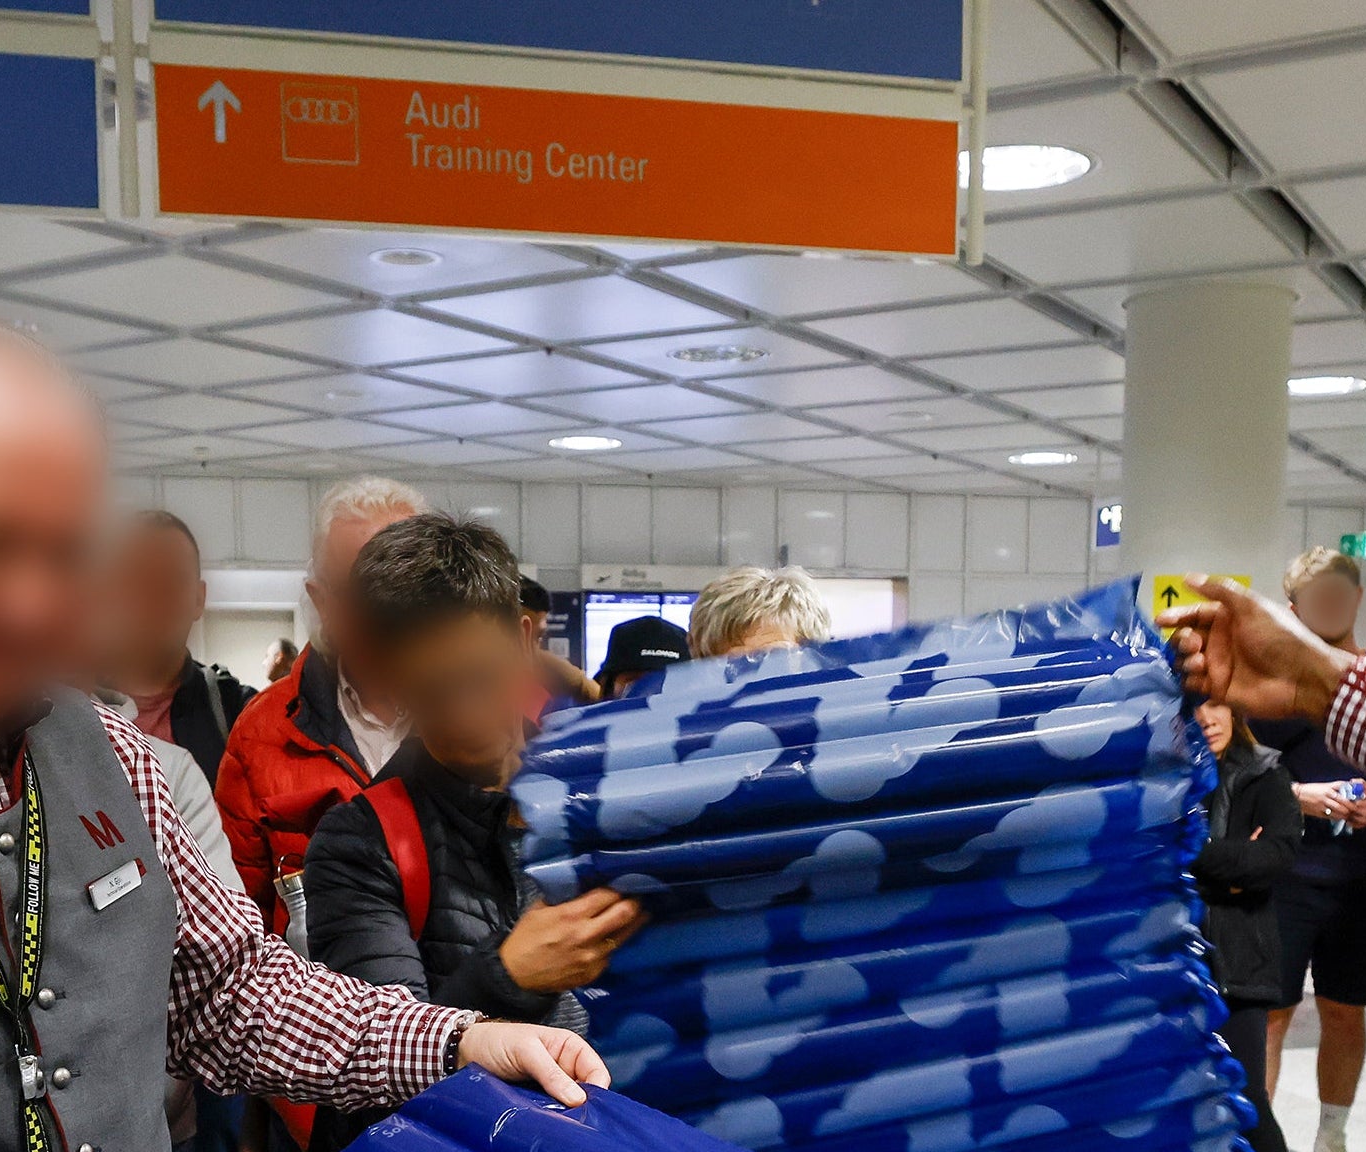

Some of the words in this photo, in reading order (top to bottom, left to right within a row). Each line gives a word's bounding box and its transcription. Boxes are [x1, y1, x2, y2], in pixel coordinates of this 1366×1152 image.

[405, 90, 481, 130] Audi
[405, 133, 533, 184] Training
[545, 142, 649, 183] Center
[78, 810, 126, 850] M
[28, 862, 40, 878] ME
[27, 877, 40, 914] FOLLOW
